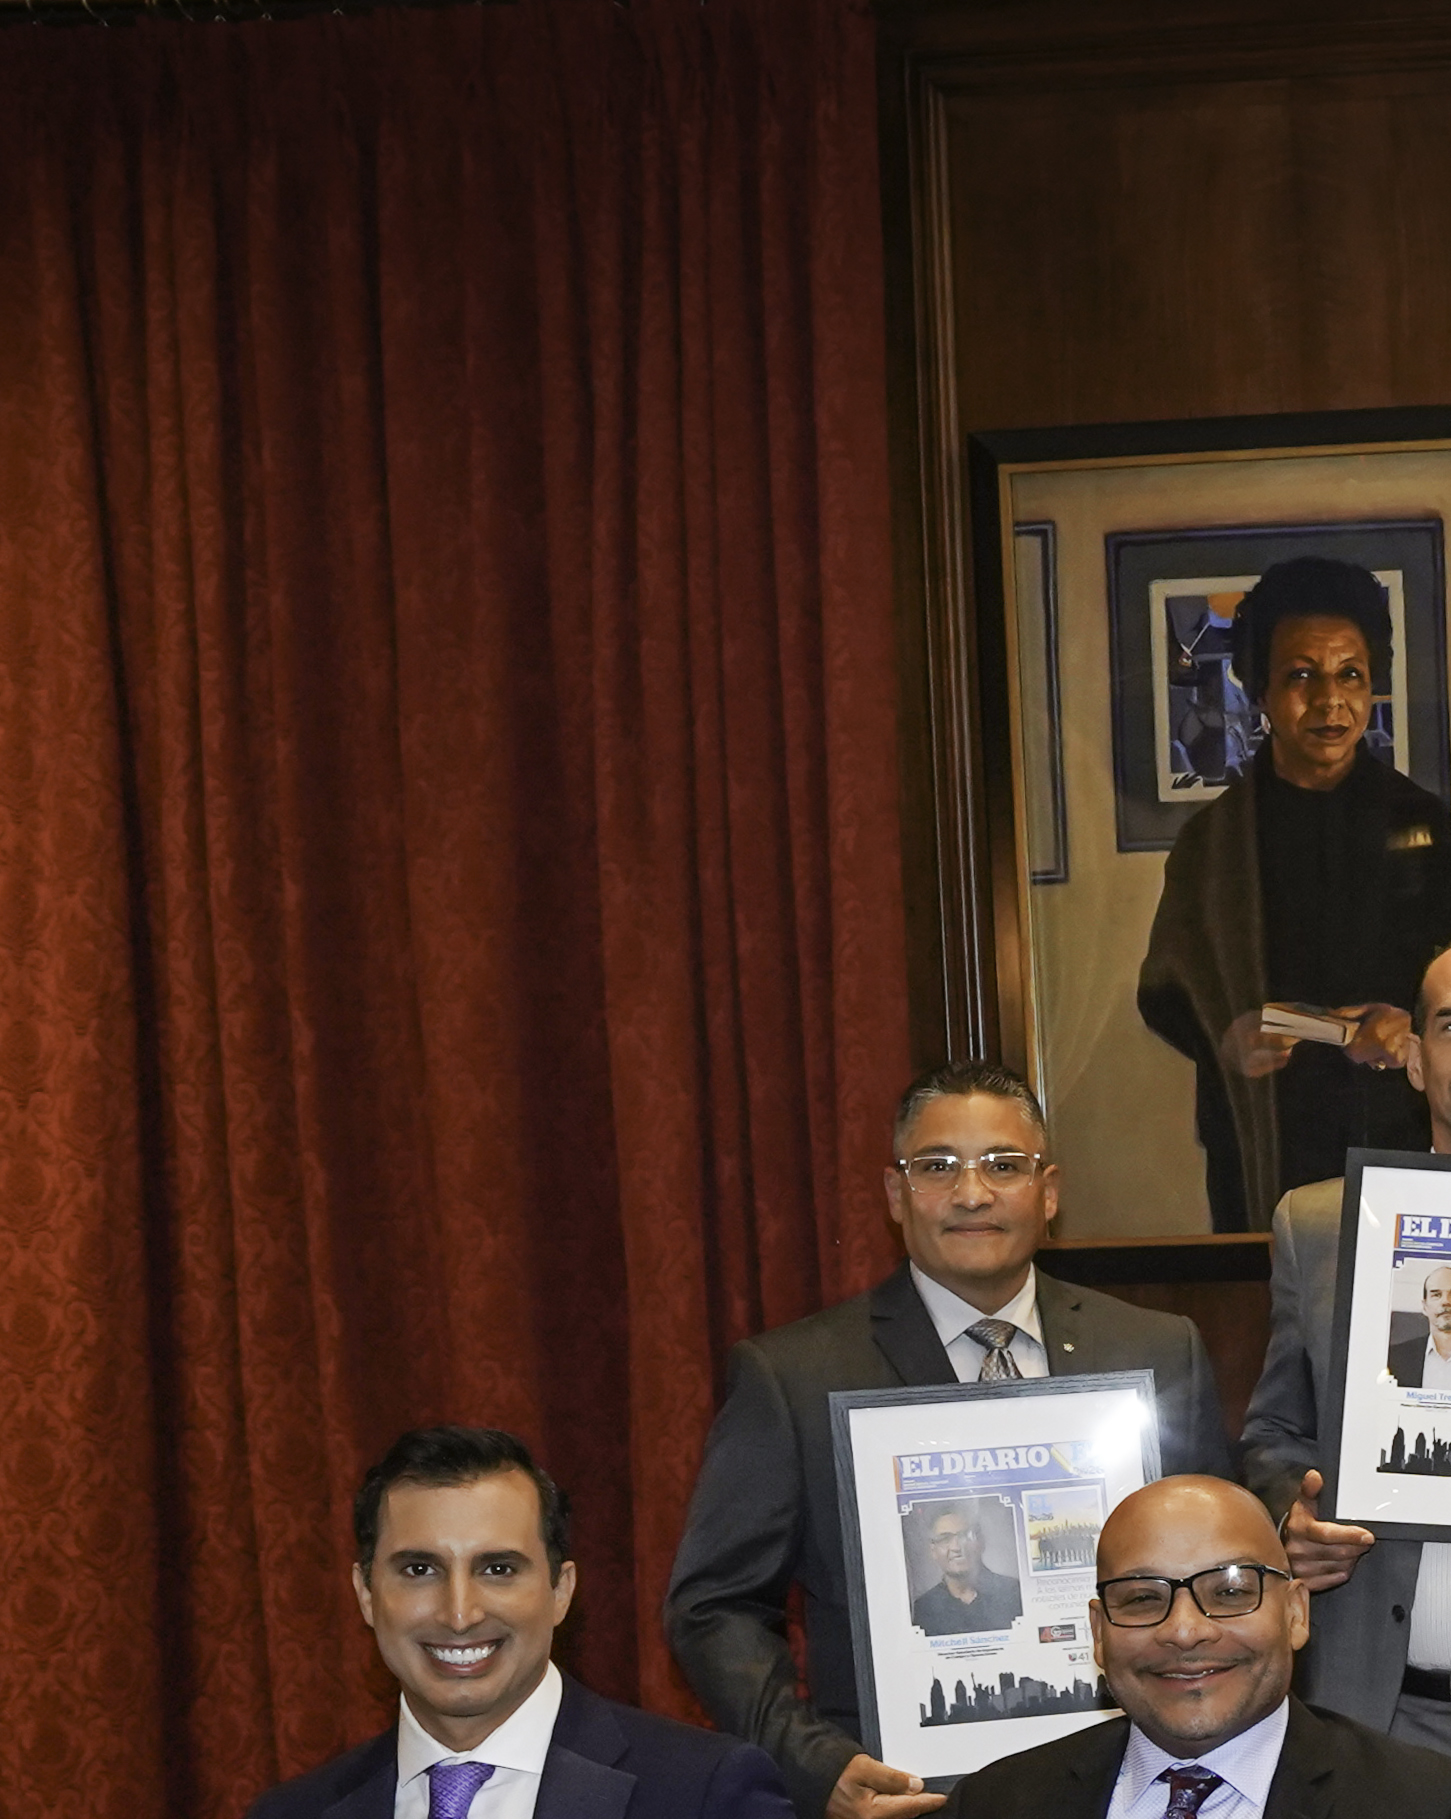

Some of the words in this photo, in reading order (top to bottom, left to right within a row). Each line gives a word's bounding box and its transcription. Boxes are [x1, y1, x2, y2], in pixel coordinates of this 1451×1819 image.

[1402, 1215, 1436, 1236] EL
[1406, 1391, 1436, 1401] Miguel
[901, 1454, 938, 1477] EL
[940, 1446, 1050, 1474] DIARIO
